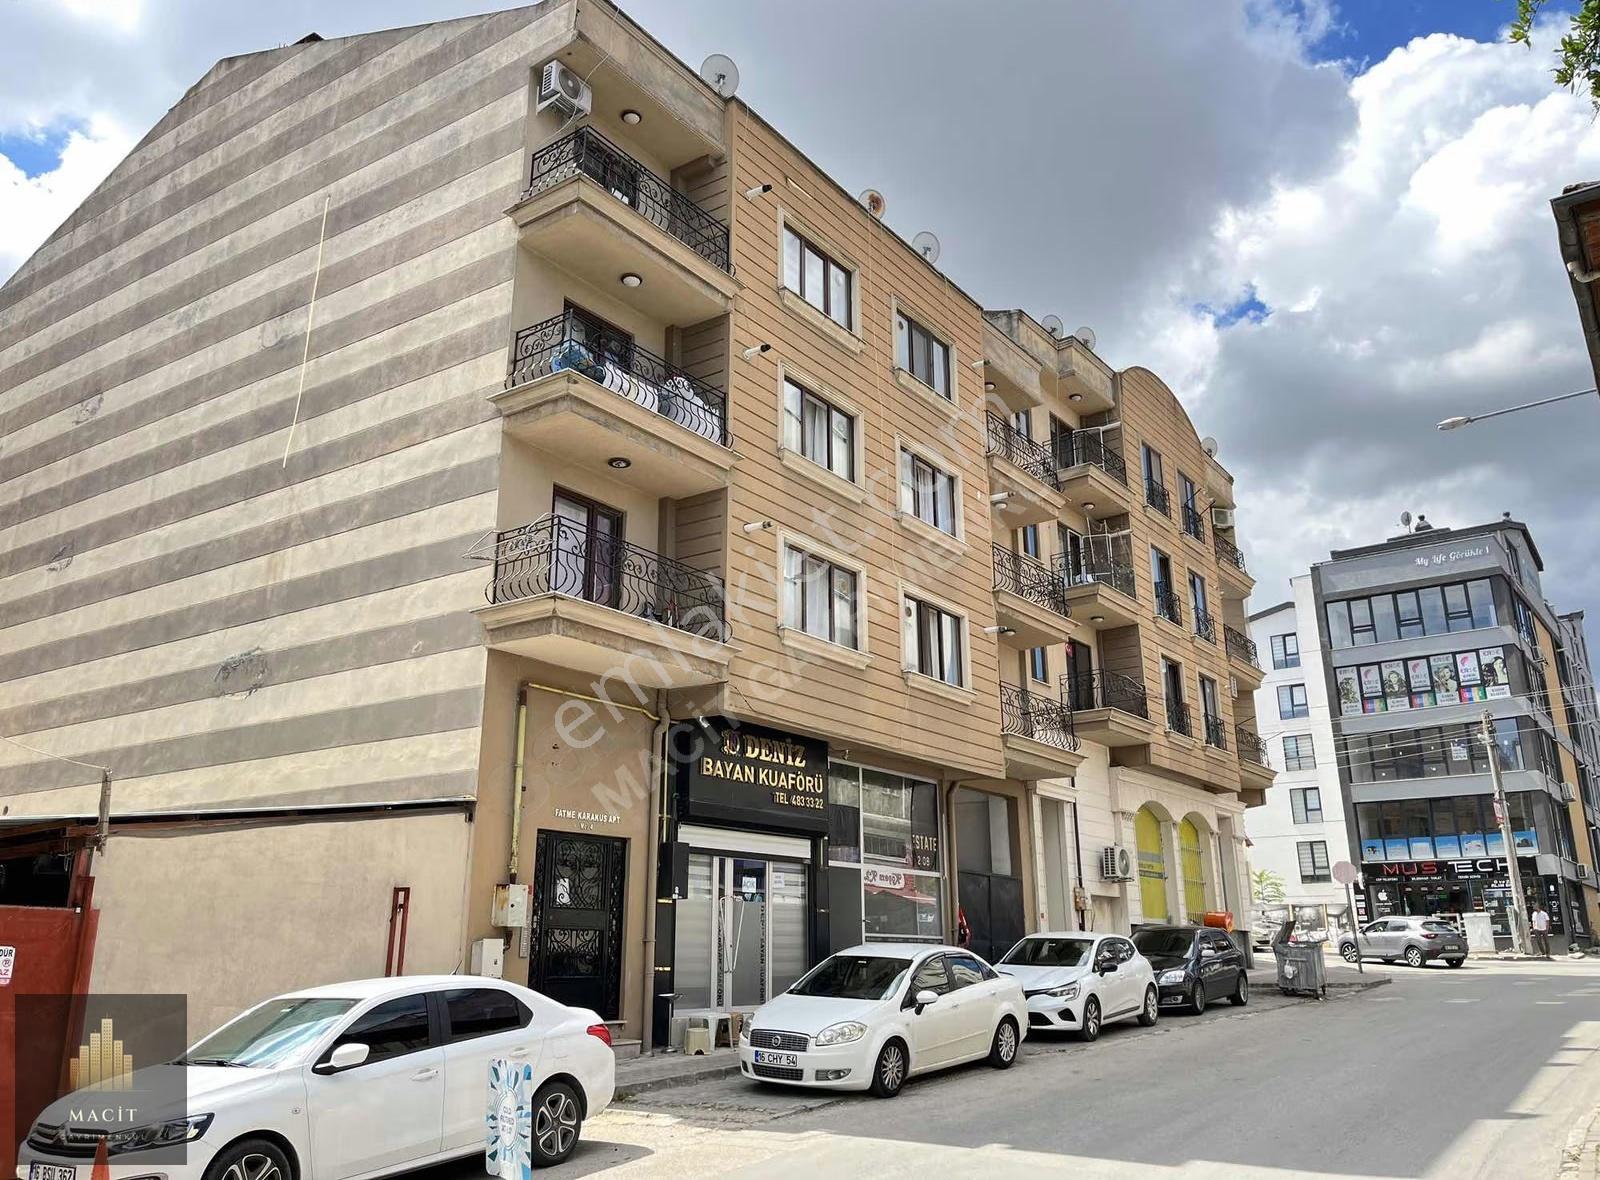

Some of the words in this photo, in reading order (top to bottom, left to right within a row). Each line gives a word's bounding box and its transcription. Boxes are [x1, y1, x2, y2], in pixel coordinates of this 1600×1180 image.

[1415, 556, 1429, 567] My
[744, 734, 806, 768] DENİZ
[702, 757, 755, 783] BAYAN
[758, 767, 824, 794] KUAFÖRÜ
[774, 791, 788, 805] TEL
[555, 808, 576, 819] FATME
[758, 1052, 766, 1062] 16
[768, 1053, 783, 1064] CHY
[786, 1055, 796, 1065] 54
[33, 1164, 40, 1180] 16
